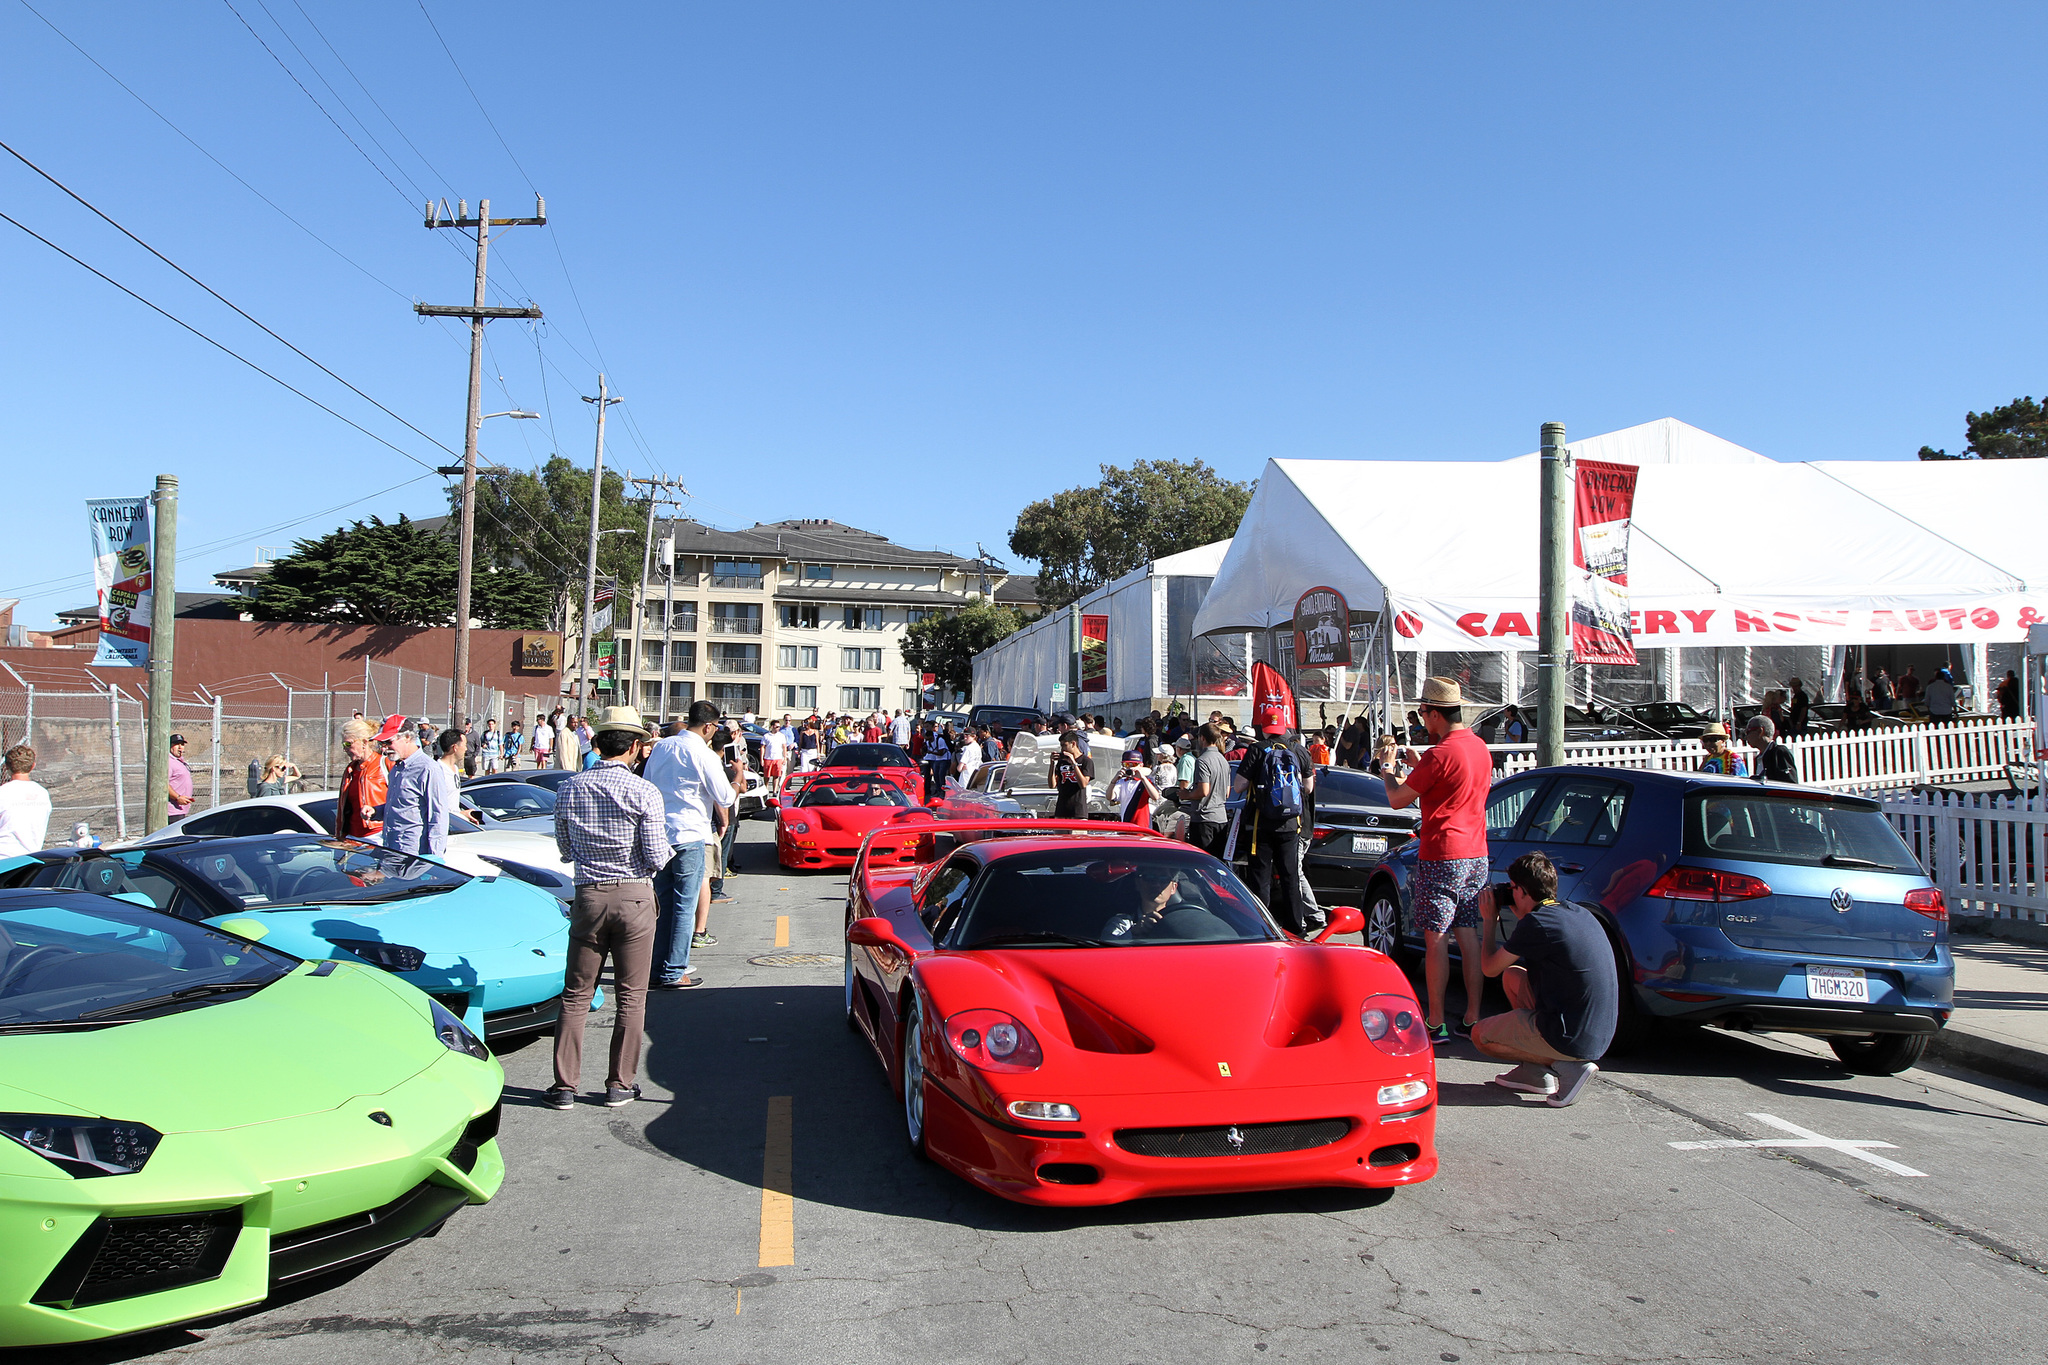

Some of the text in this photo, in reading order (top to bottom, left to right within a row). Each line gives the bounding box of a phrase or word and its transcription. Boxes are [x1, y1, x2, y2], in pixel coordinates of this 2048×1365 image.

[1581, 470, 1633, 493] CANNERY
[1591, 495, 1616, 514] ROW
[93, 505, 144, 523] CANNERY
[109, 525, 133, 541] ROW
[111, 595, 136, 607] SILVER
[112, 589, 138, 600] CAPTAIN
[1301, 592, 1337, 616] GRAND ENTRANCE
[1456, 608, 1717, 637] CARY
[1869, 606, 2000, 633] AUTO
[2016, 606, 2046, 629] &
[1308, 646, 1335, 663] Welcome
[1726, 914, 1758, 923] GOLF
[1818, 967, 1855, 978] California
[1811, 977, 1864, 997] 7HGM320
